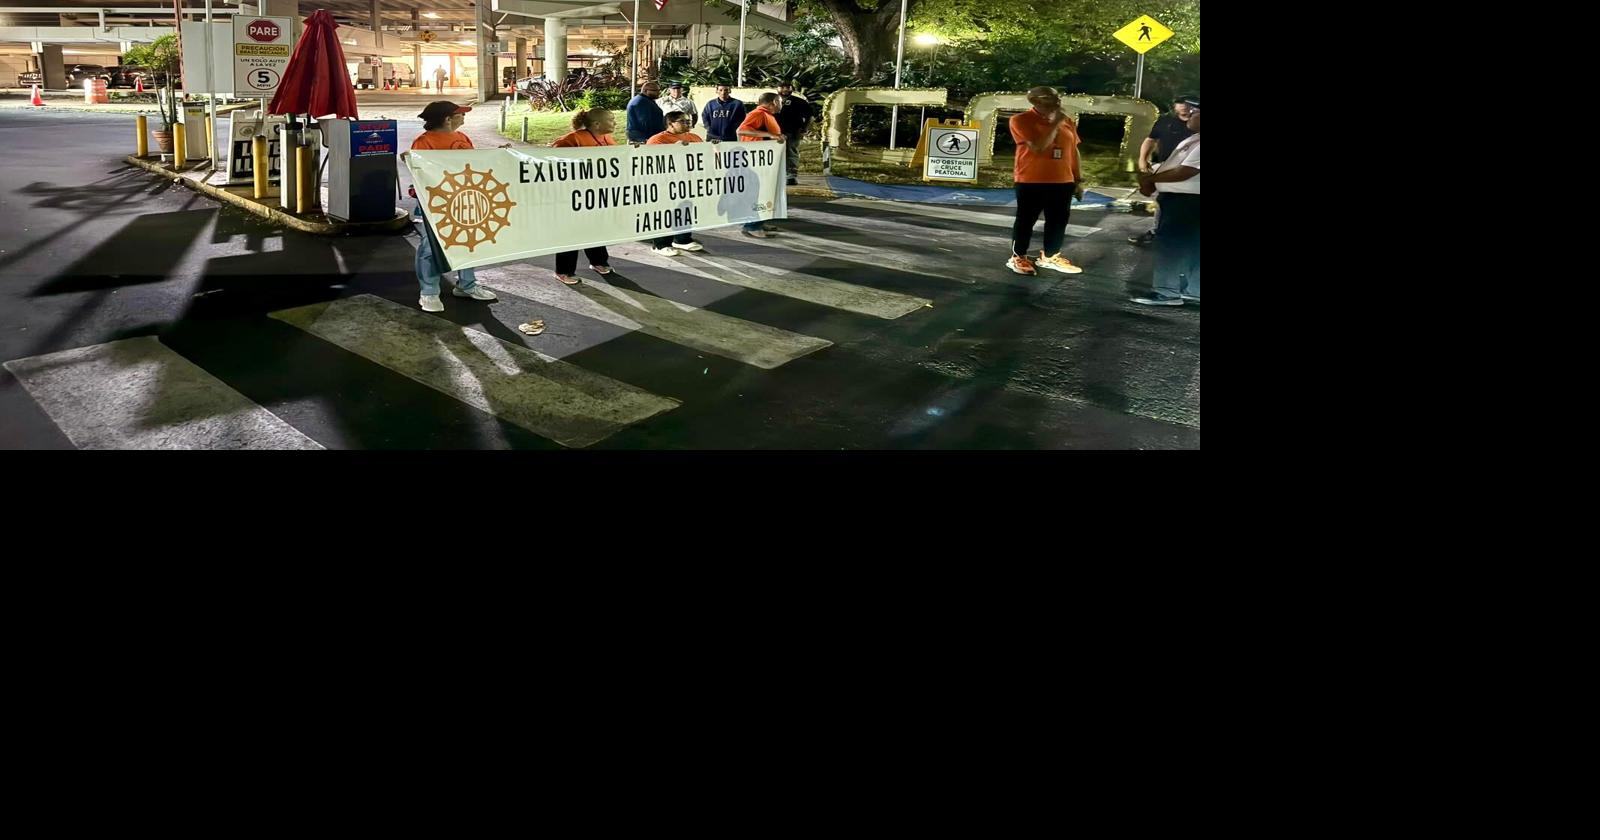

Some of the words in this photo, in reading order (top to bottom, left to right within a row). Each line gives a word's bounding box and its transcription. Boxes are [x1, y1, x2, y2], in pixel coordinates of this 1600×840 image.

[249, 26, 278, 36] PARE
[257, 71, 270, 83] 5
[519, 158, 620, 184] EXIGIMOS
[632, 154, 676, 177] FIRMA
[686, 153, 704, 172] DE
[715, 149, 774, 170] NUESTRO
[451, 190, 489, 225] HEEND
[571, 183, 658, 211] CONVENIO
[669, 175, 745, 200] COLECTIVO
[636, 206, 698, 233] ¡AHORA!
